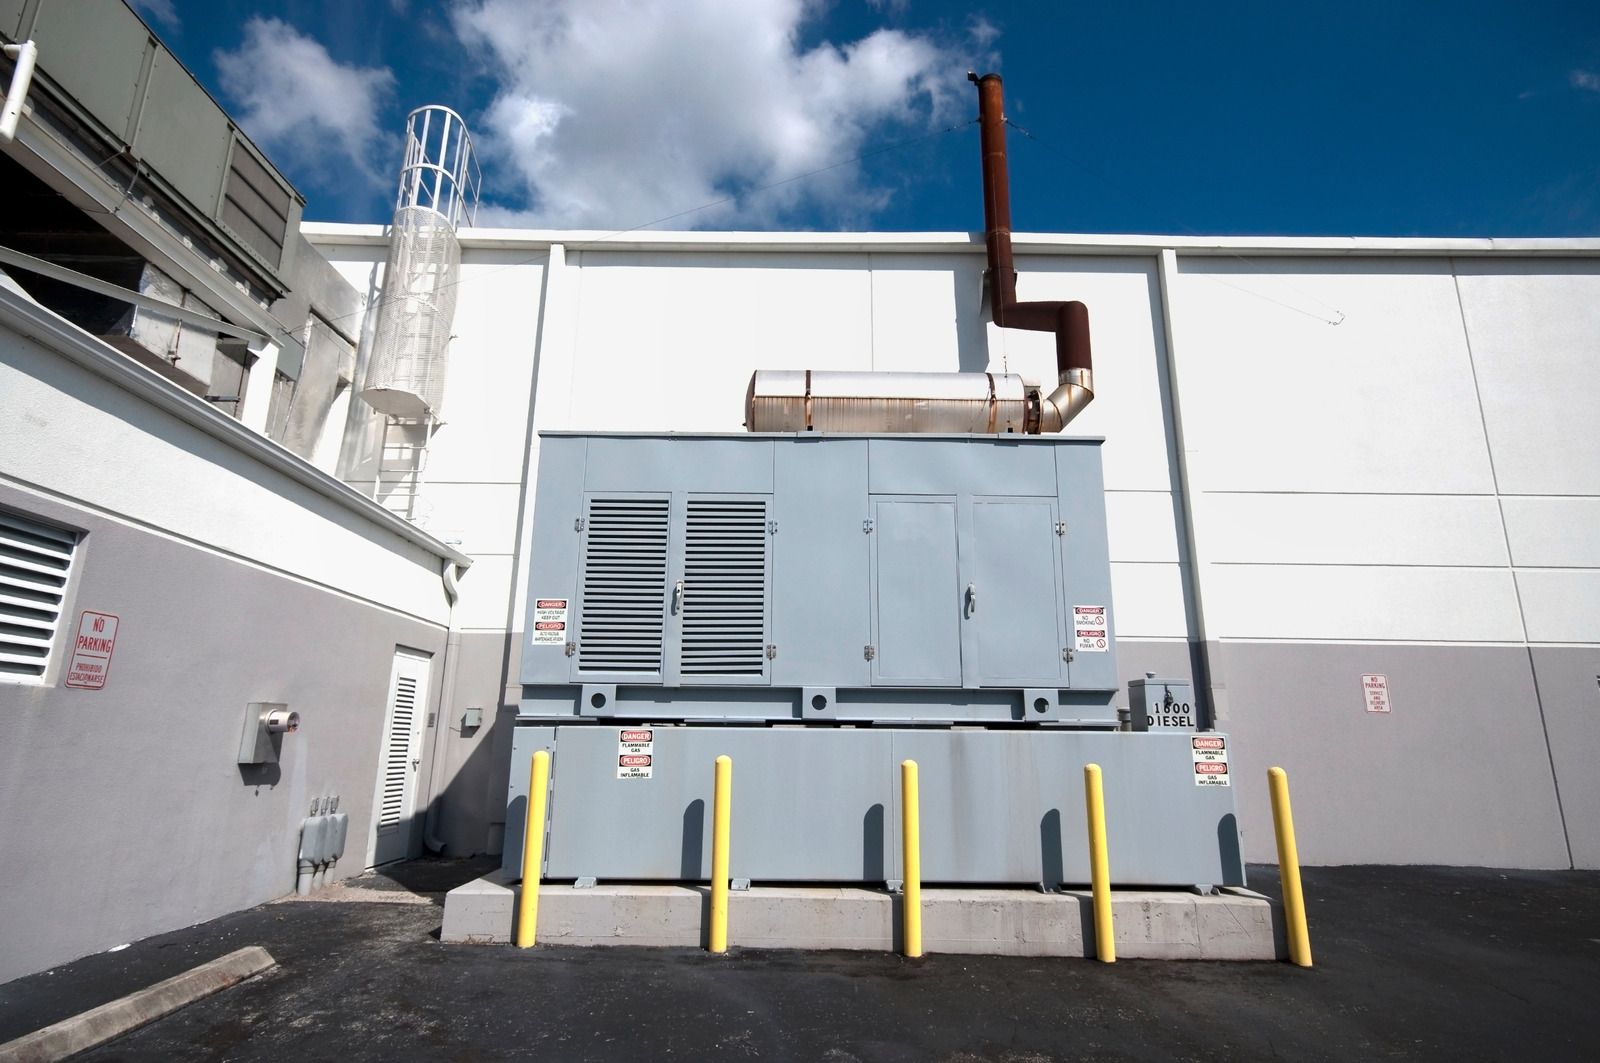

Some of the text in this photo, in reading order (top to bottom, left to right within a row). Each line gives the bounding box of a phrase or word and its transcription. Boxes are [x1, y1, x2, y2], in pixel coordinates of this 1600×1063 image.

[93, 617, 105, 632] NO
[77, 635, 112, 653] PARKING
[75, 662, 103, 674] PROHIBIDO
[69, 672, 105, 684] ESTACIONARSE
[1155, 702, 1190, 714] 1600
[1147, 715, 1195, 727] DIESEL
